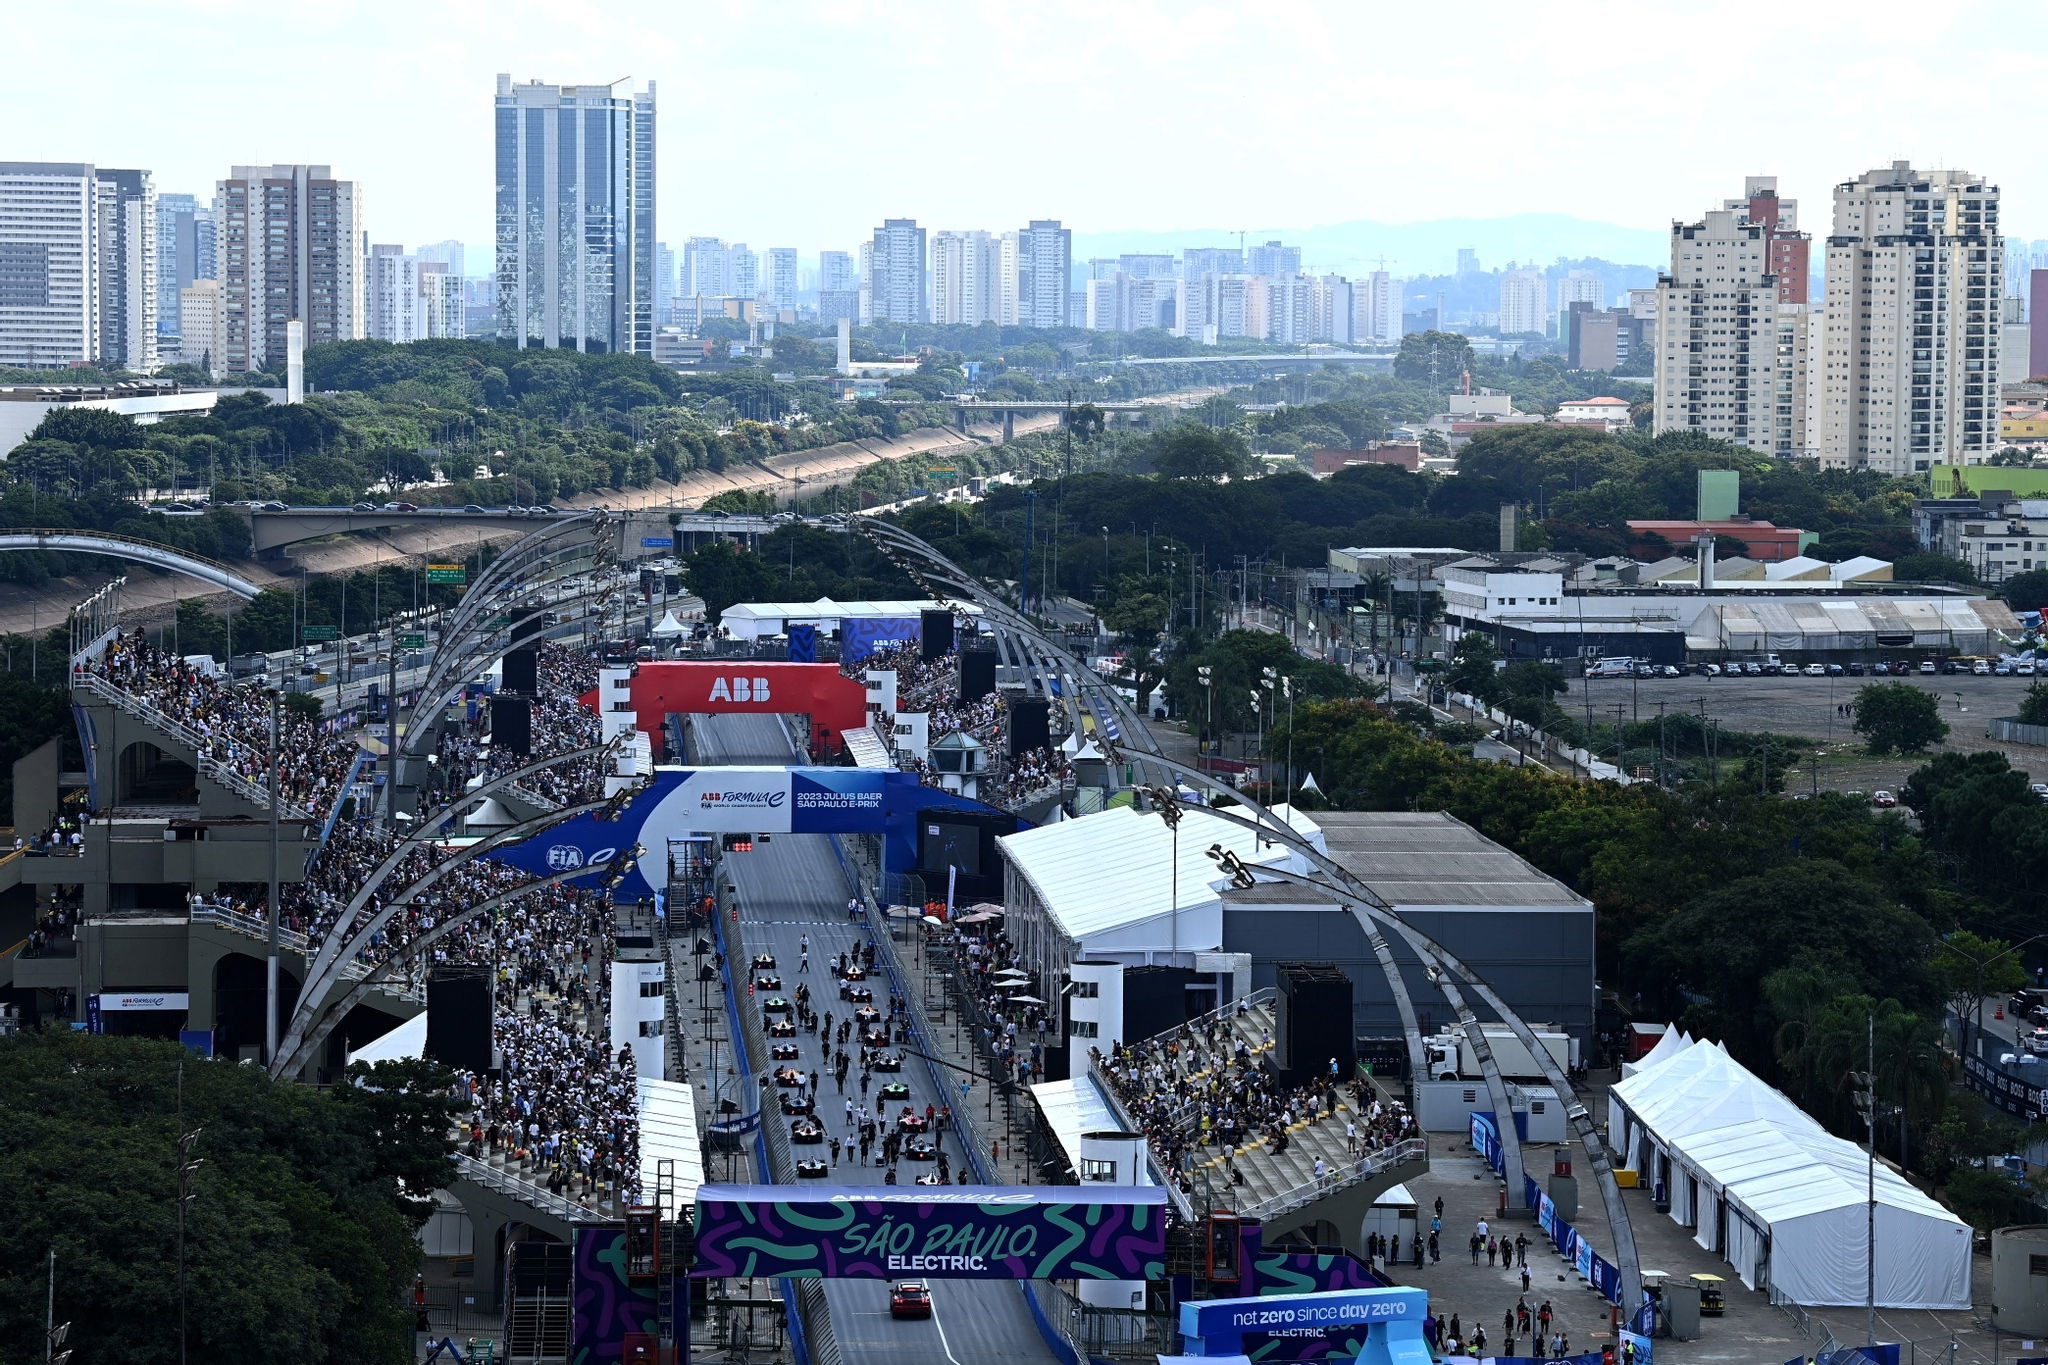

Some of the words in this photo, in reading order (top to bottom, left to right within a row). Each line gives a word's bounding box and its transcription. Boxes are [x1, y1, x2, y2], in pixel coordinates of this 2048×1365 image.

[708, 677, 771, 702] ABB
[701, 792, 721, 801] ABB
[721, 792, 769, 802] FORMULA
[797, 792, 822, 800] 2023
[823, 792, 856, 800] JULIUS
[857, 792, 882, 800] BAER
[818, 800, 847, 808] PAULO
[849, 800, 879, 808] E-PRIX
[2010, 1082, 2024, 1098] BOSS
[839, 1214, 915, 1259] SÃO
[888, 1255, 988, 1271] ELECTRIC.
[1233, 1310, 1258, 1326] net
[1259, 1309, 1295, 1324] zero
[1297, 1306, 1338, 1322] since
[1340, 1303, 1369, 1319] day
[1371, 1301, 1407, 1316] zero
